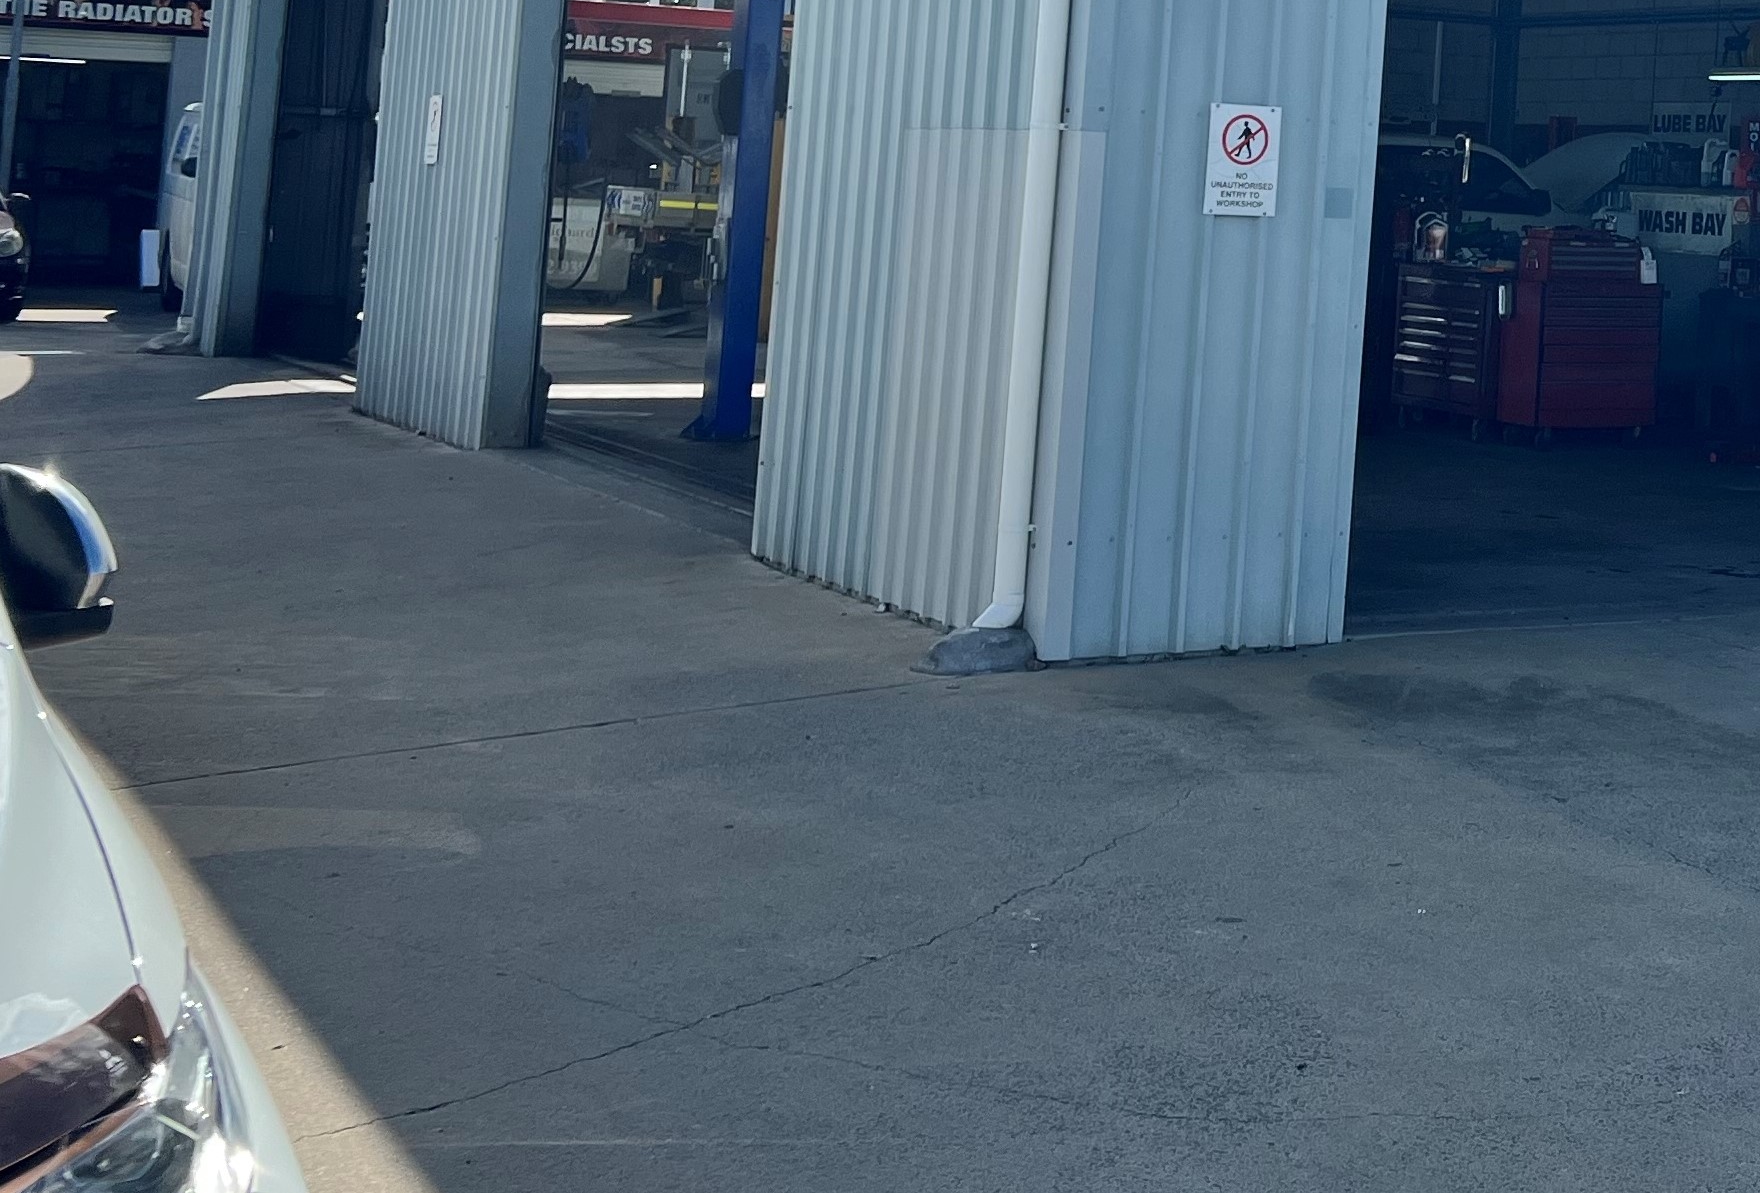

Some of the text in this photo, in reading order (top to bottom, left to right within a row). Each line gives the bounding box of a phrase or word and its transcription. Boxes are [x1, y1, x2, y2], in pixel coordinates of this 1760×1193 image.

[58, 0, 193, 26] RADIATOR
[1653, 114, 1727, 133] LUBE BAY
[1235, 172, 1248, 180] NO
[1210, 180, 1274, 191] UNAUTHORISED
[1220, 190, 1247, 199] ENTRY
[1216, 199, 1264, 208] WORKSHOP
[1638, 209, 1727, 236] WASH BAY
